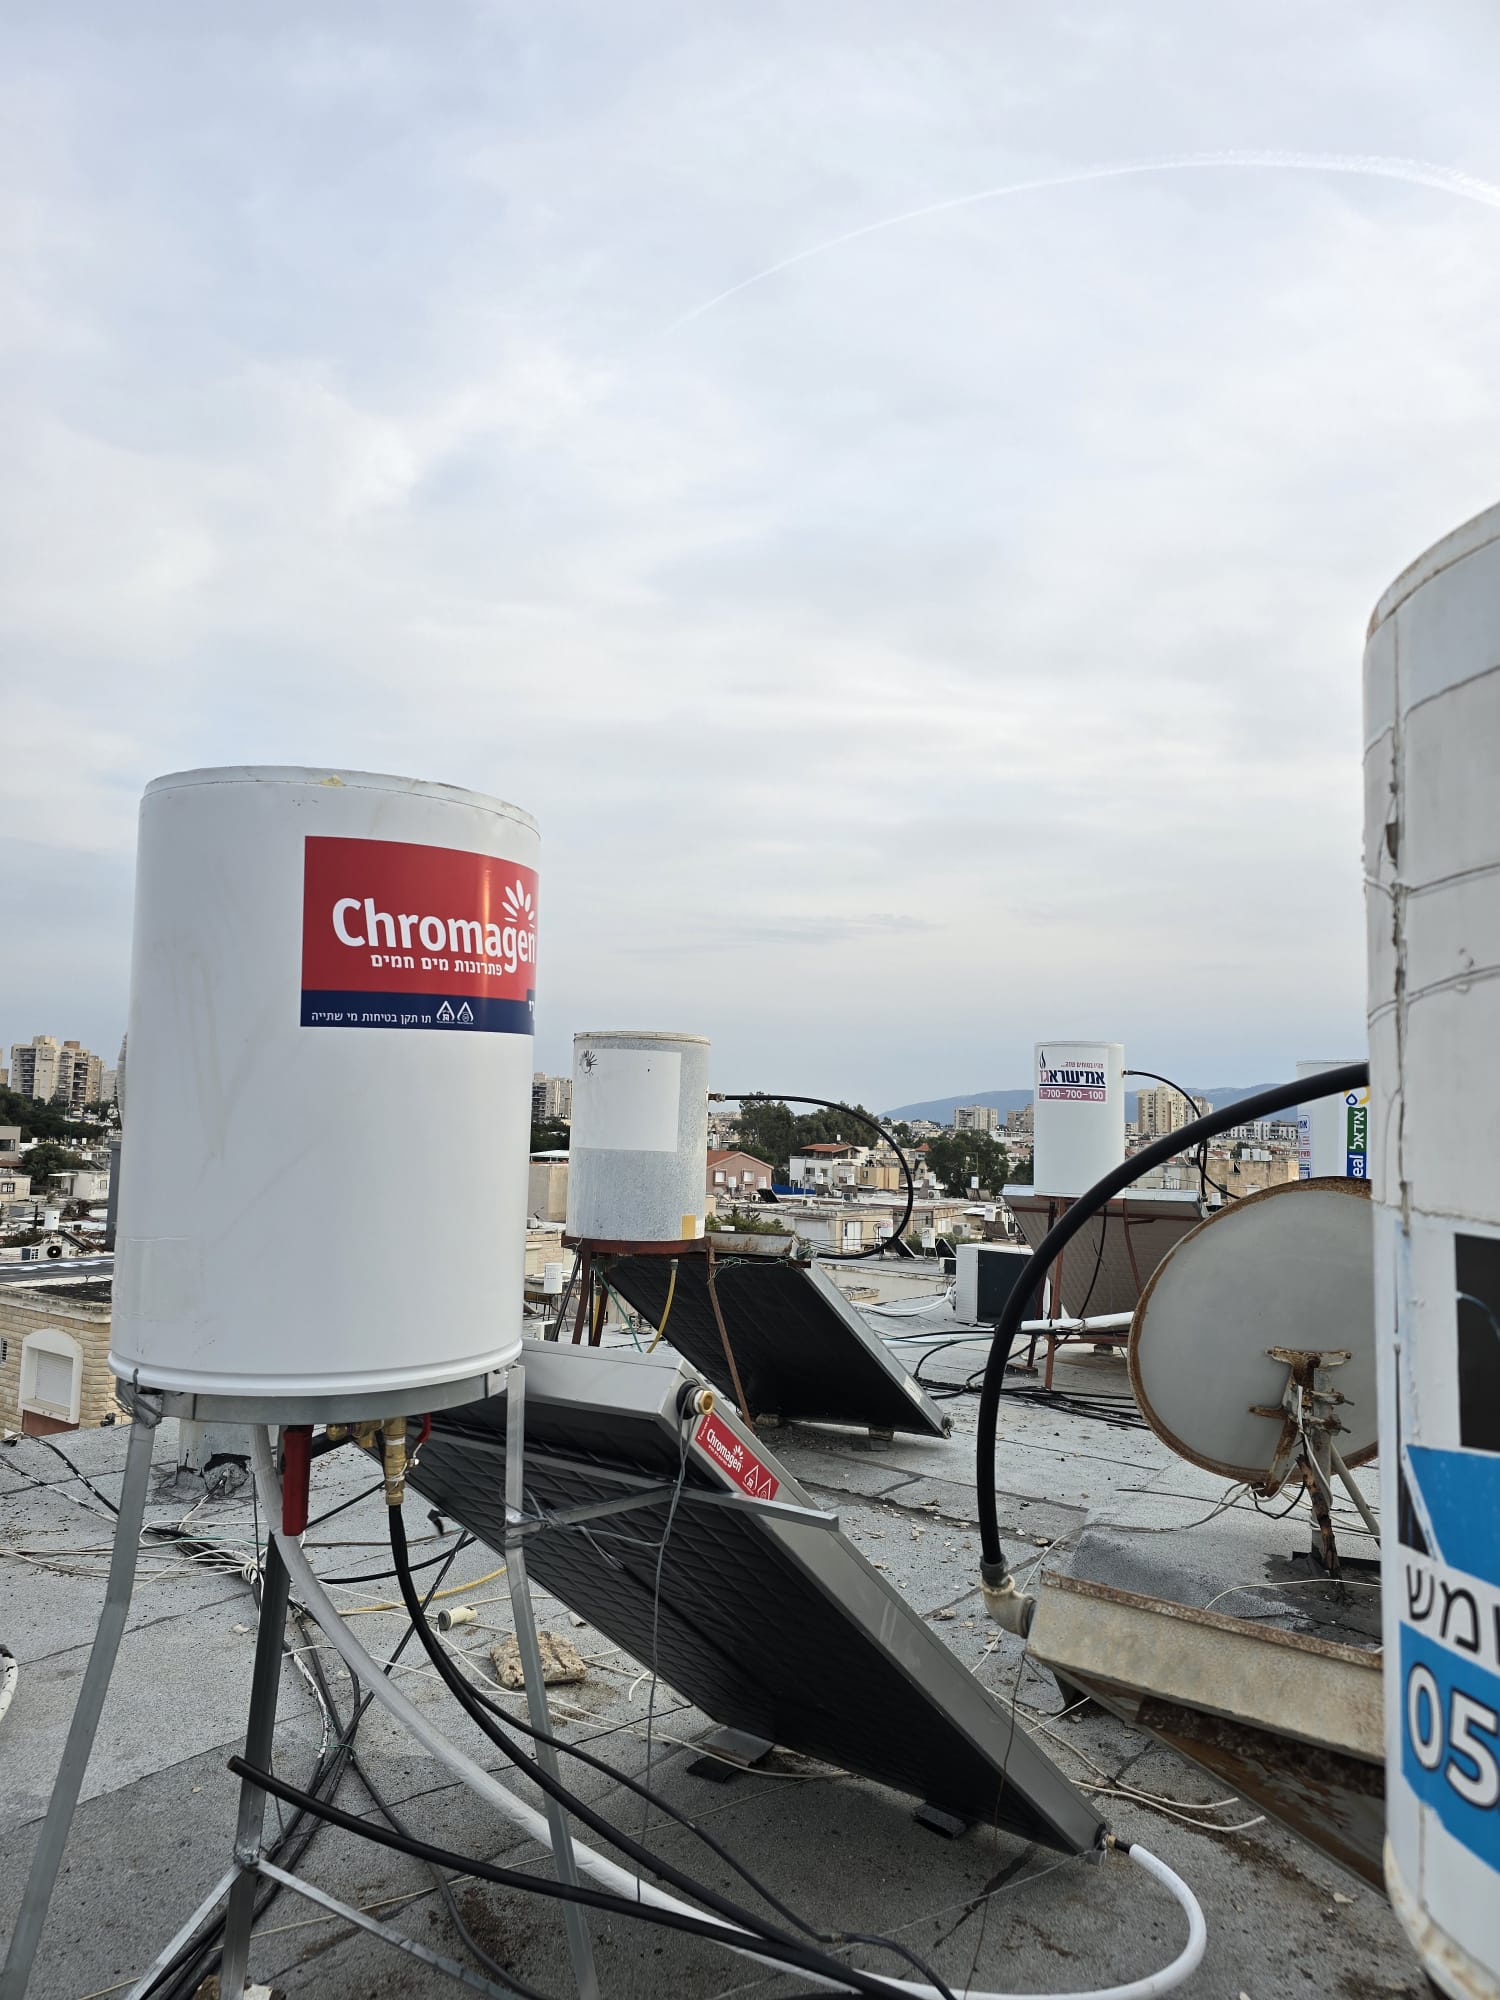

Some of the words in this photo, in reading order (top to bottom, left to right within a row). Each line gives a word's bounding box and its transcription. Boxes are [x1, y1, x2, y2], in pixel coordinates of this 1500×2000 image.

[332, 897, 535, 973] Chromagen
[370, 954, 415, 969] חמים
[421, 957, 449, 971] מים
[454, 959, 503, 976] פתרונות
[311, 1011, 343, 1022] שתייה
[346, 1011, 358, 1022] מי
[361, 1012, 397, 1023] בטיחות
[401, 1013, 418, 1025] תקן
[421, 1013, 432, 1024] תו
[1040, 1089, 1104, 1100] 1-700-700-100
[1349, 1110, 1365, 1150] אידאל
[1348, 1154, 1364, 1177] eal
[706, 1428, 742, 1473] Chromagen
[1406, 1564, 1500, 1666] מש
